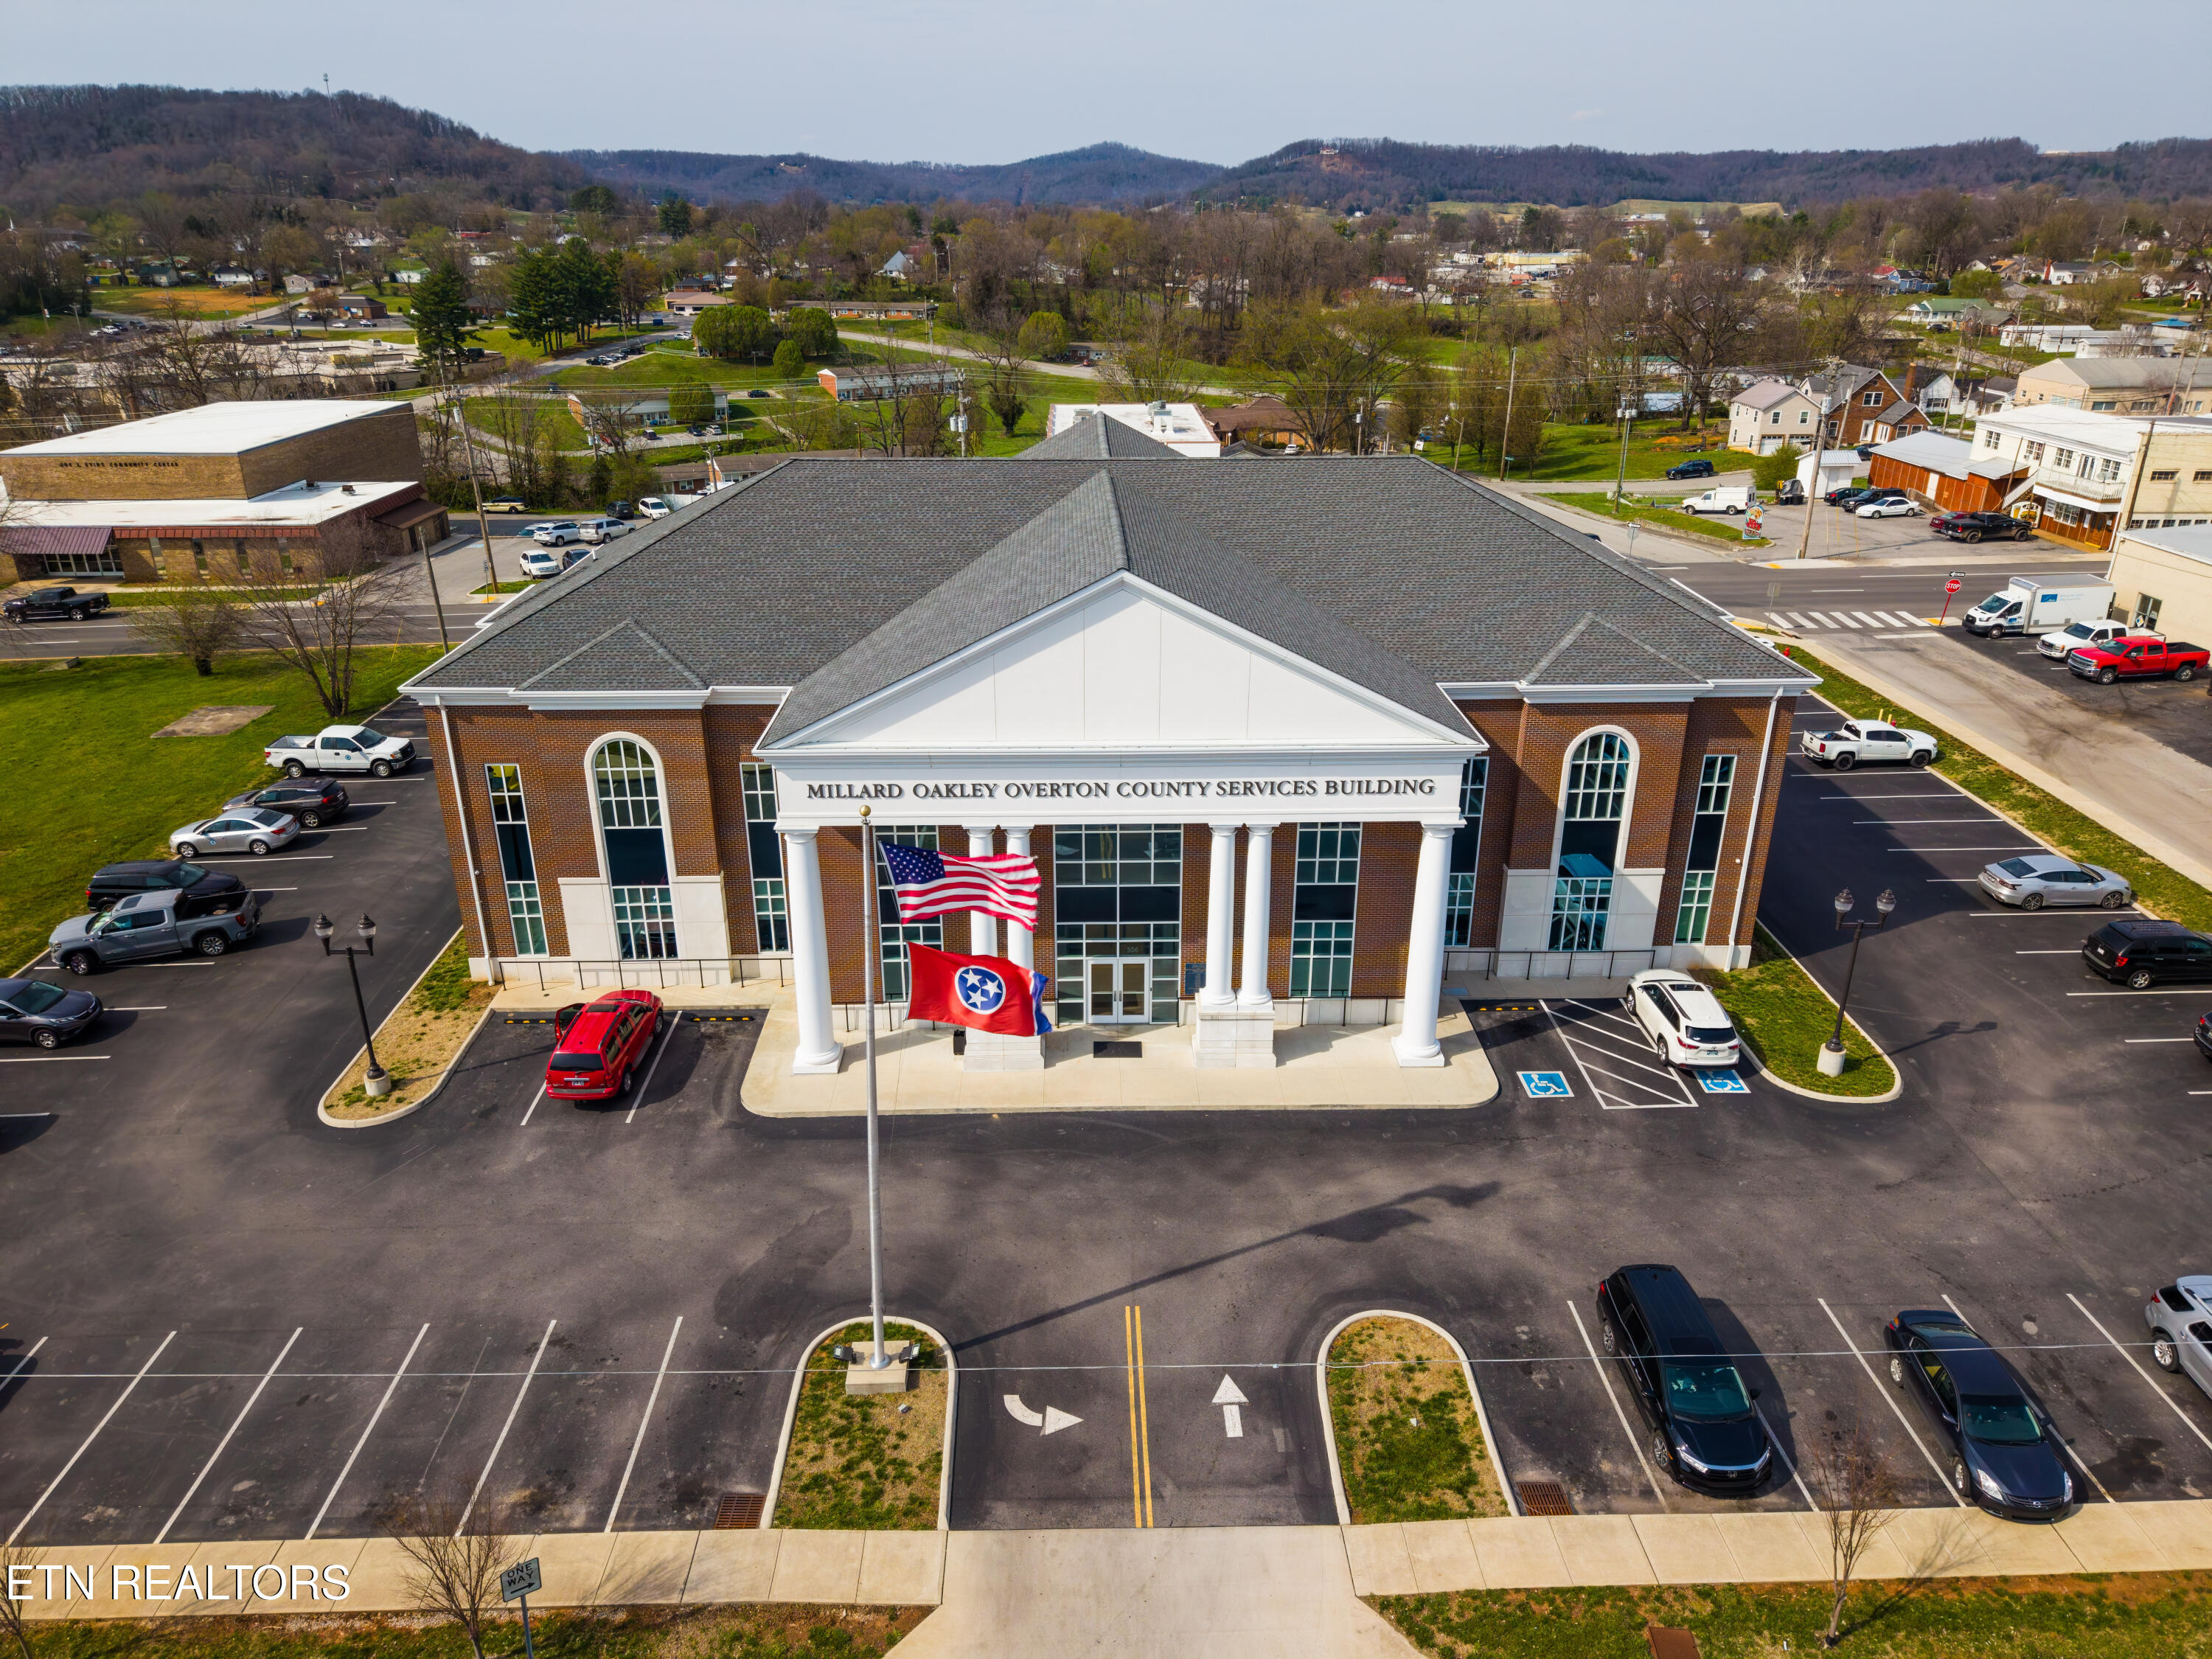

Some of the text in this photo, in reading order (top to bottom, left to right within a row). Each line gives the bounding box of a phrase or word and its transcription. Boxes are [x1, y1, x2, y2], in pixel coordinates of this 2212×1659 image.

[807, 779, 1435, 799] MILLARD OAKLEY OVERTON COUNTY SERVICES BUILDING
[507, 1563, 532, 1578] ONE
[507, 1571, 534, 1587] WAY
